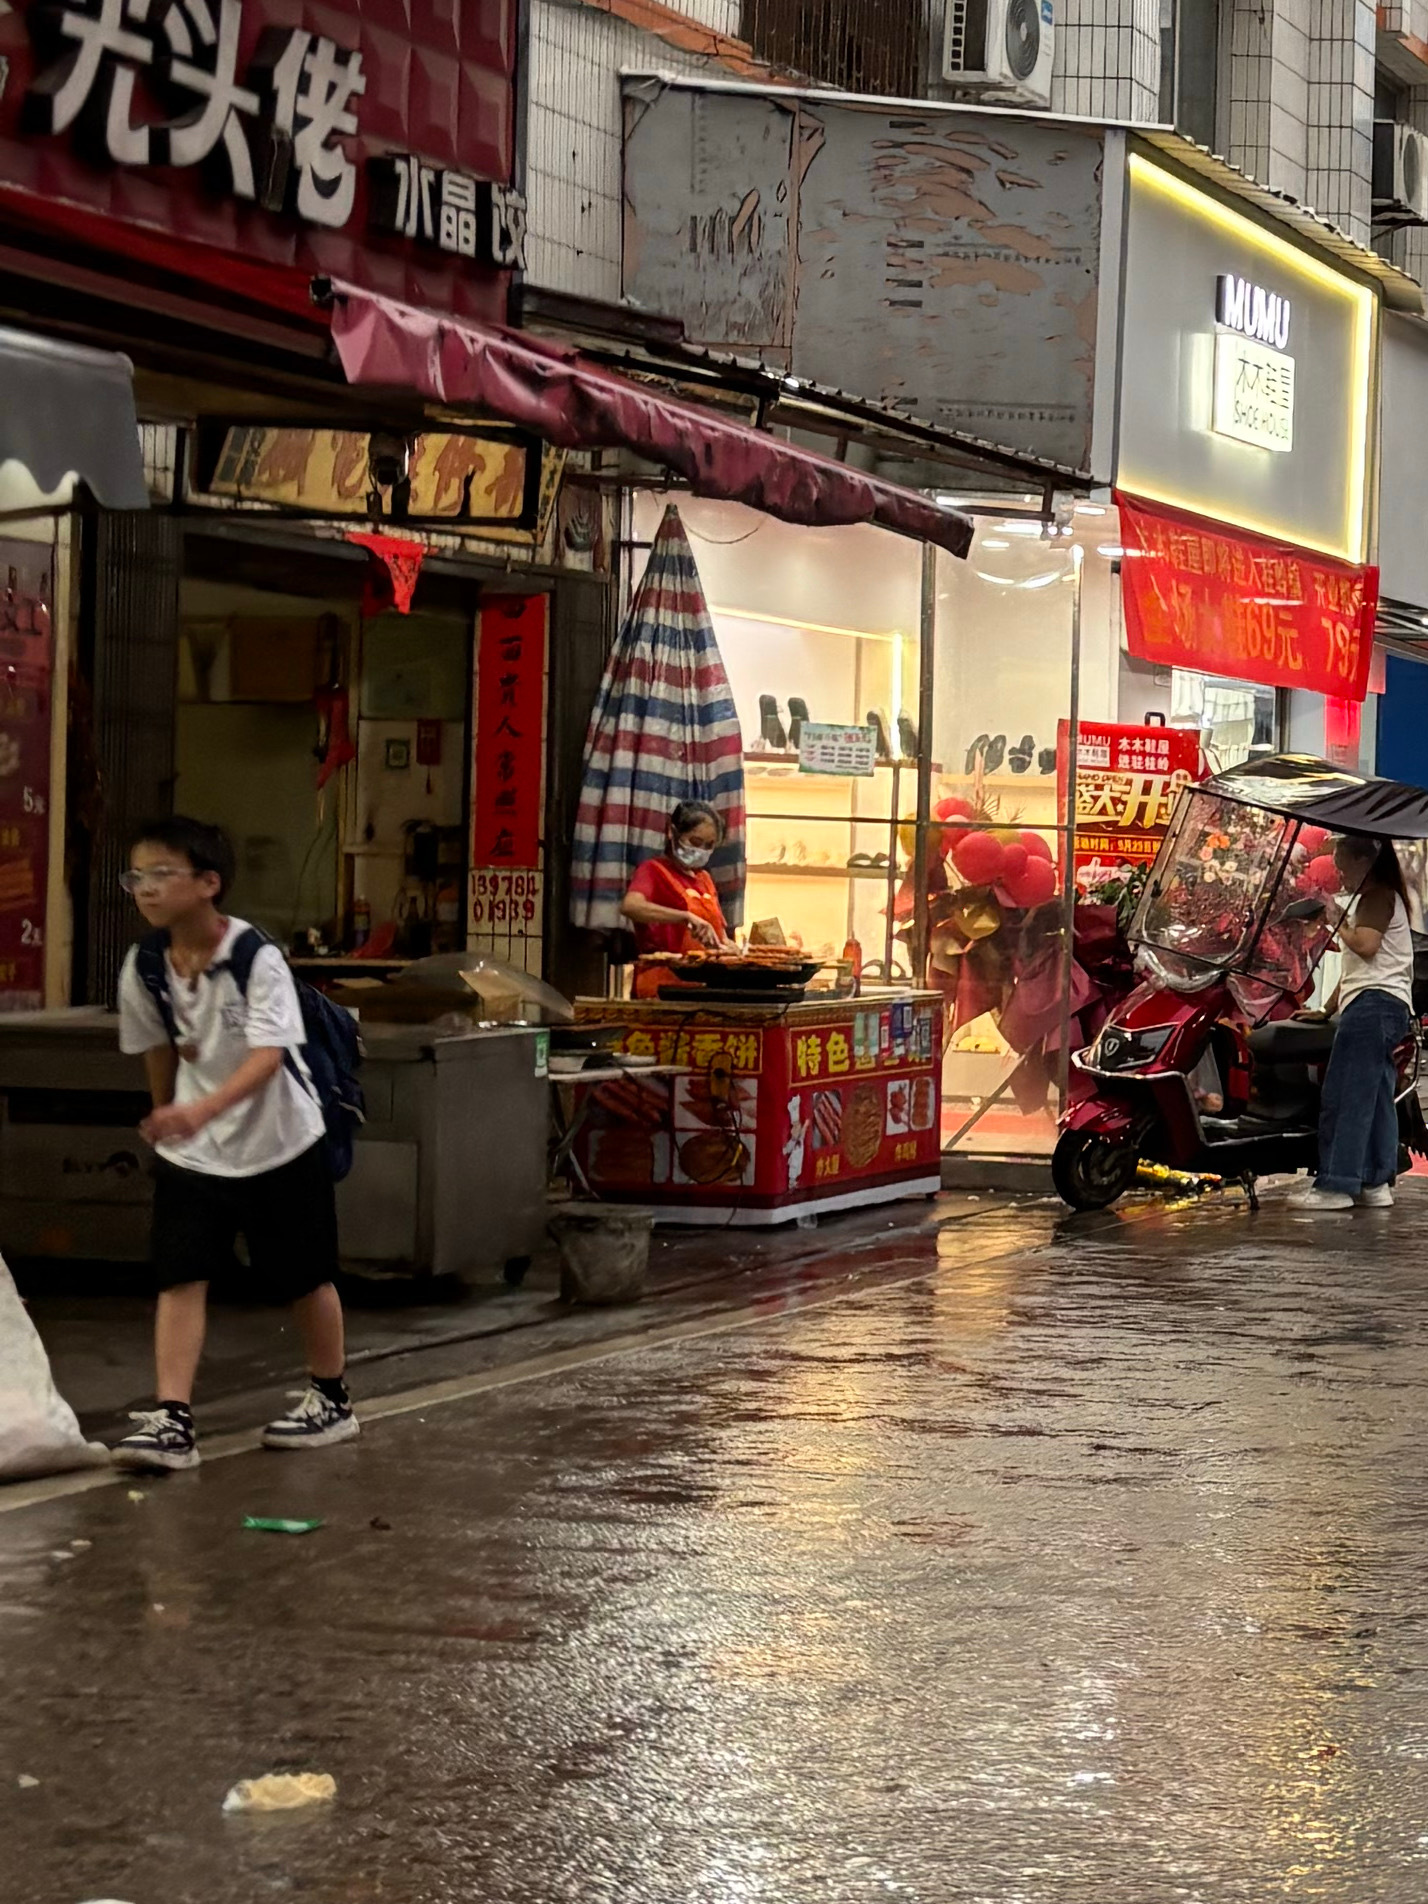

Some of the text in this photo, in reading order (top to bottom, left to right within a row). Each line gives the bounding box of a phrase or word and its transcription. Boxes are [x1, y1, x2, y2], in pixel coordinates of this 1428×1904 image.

[1224, 274, 1291, 350] MUMU
[606, 1030, 758, 1070] 色酱香饼
